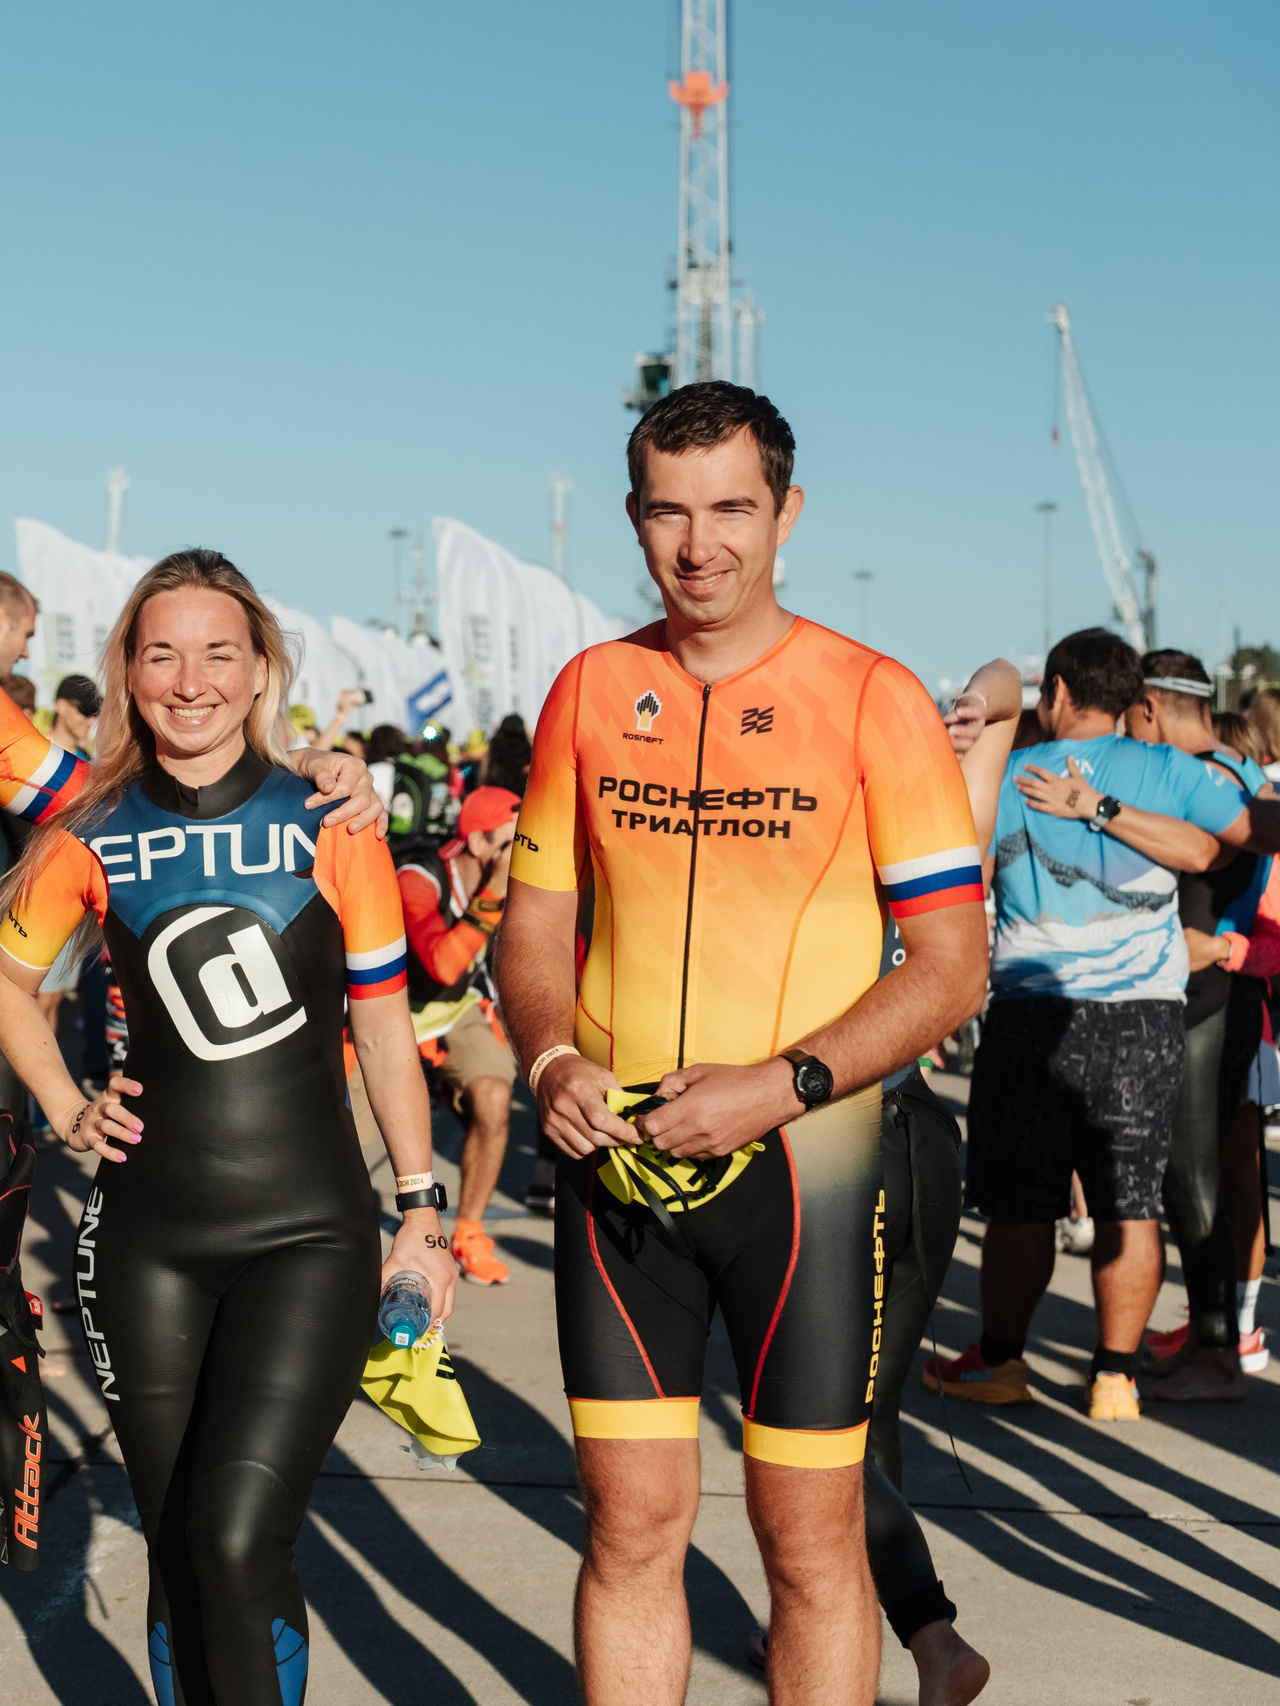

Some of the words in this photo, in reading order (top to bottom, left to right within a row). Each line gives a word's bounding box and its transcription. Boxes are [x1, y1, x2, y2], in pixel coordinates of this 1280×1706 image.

[622, 732, 664, 745] ROSNEFT
[598, 776, 818, 811] РОСНЕФТЬ
[82, 823, 316, 884] EPTUN
[612, 810, 791, 839] ТРИАТЛОН
[76, 1186, 121, 1401] NEPTUNE
[864, 1189, 885, 1404] РОСНЕФТЬ
[14, 1411, 42, 1550] Attack
